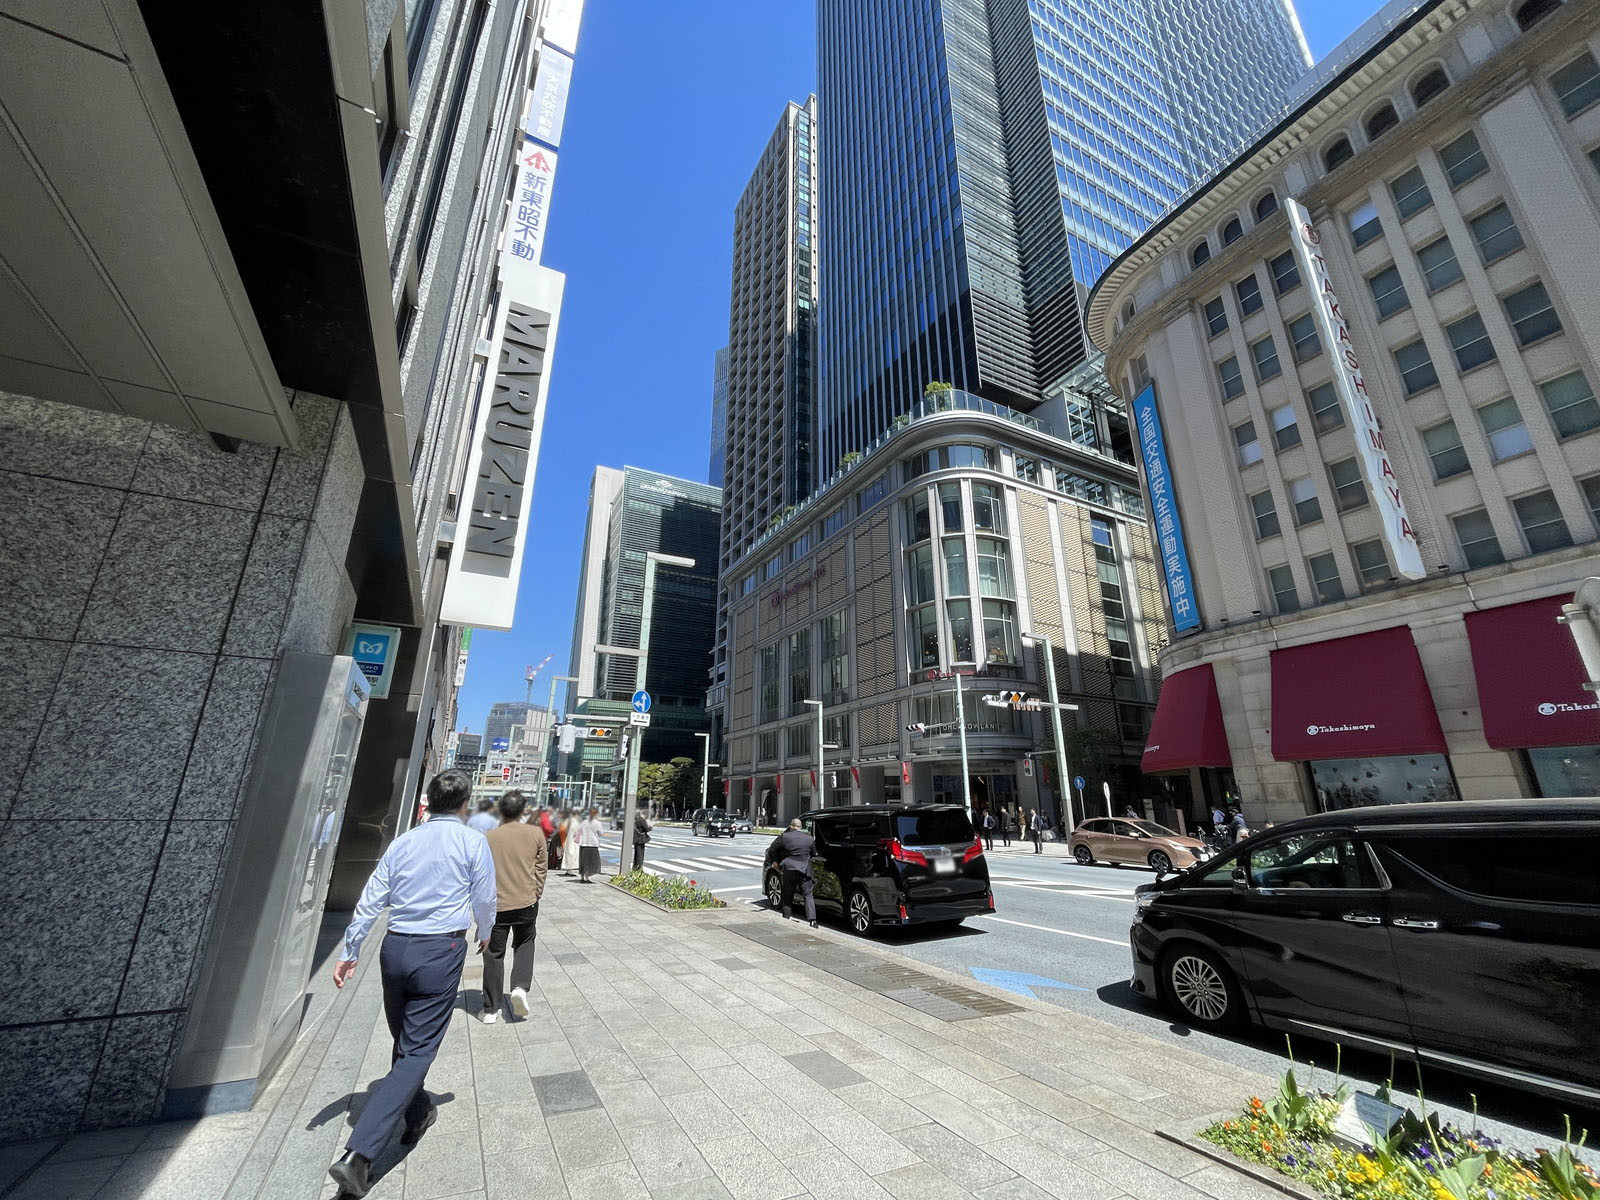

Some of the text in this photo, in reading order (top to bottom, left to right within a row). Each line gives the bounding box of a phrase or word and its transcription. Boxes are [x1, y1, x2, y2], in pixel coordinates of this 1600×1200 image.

[511, 171, 547, 261] 新東昭不動
[464, 301, 551, 560] MARUZEN
[1312, 253, 1416, 541] TAKASHIMAYA
[1141, 406, 1190, 617] 全国交通安全運動実施中
[1319, 724, 1375, 732] Takashimaya
[1557, 702, 1600, 711] Takas
